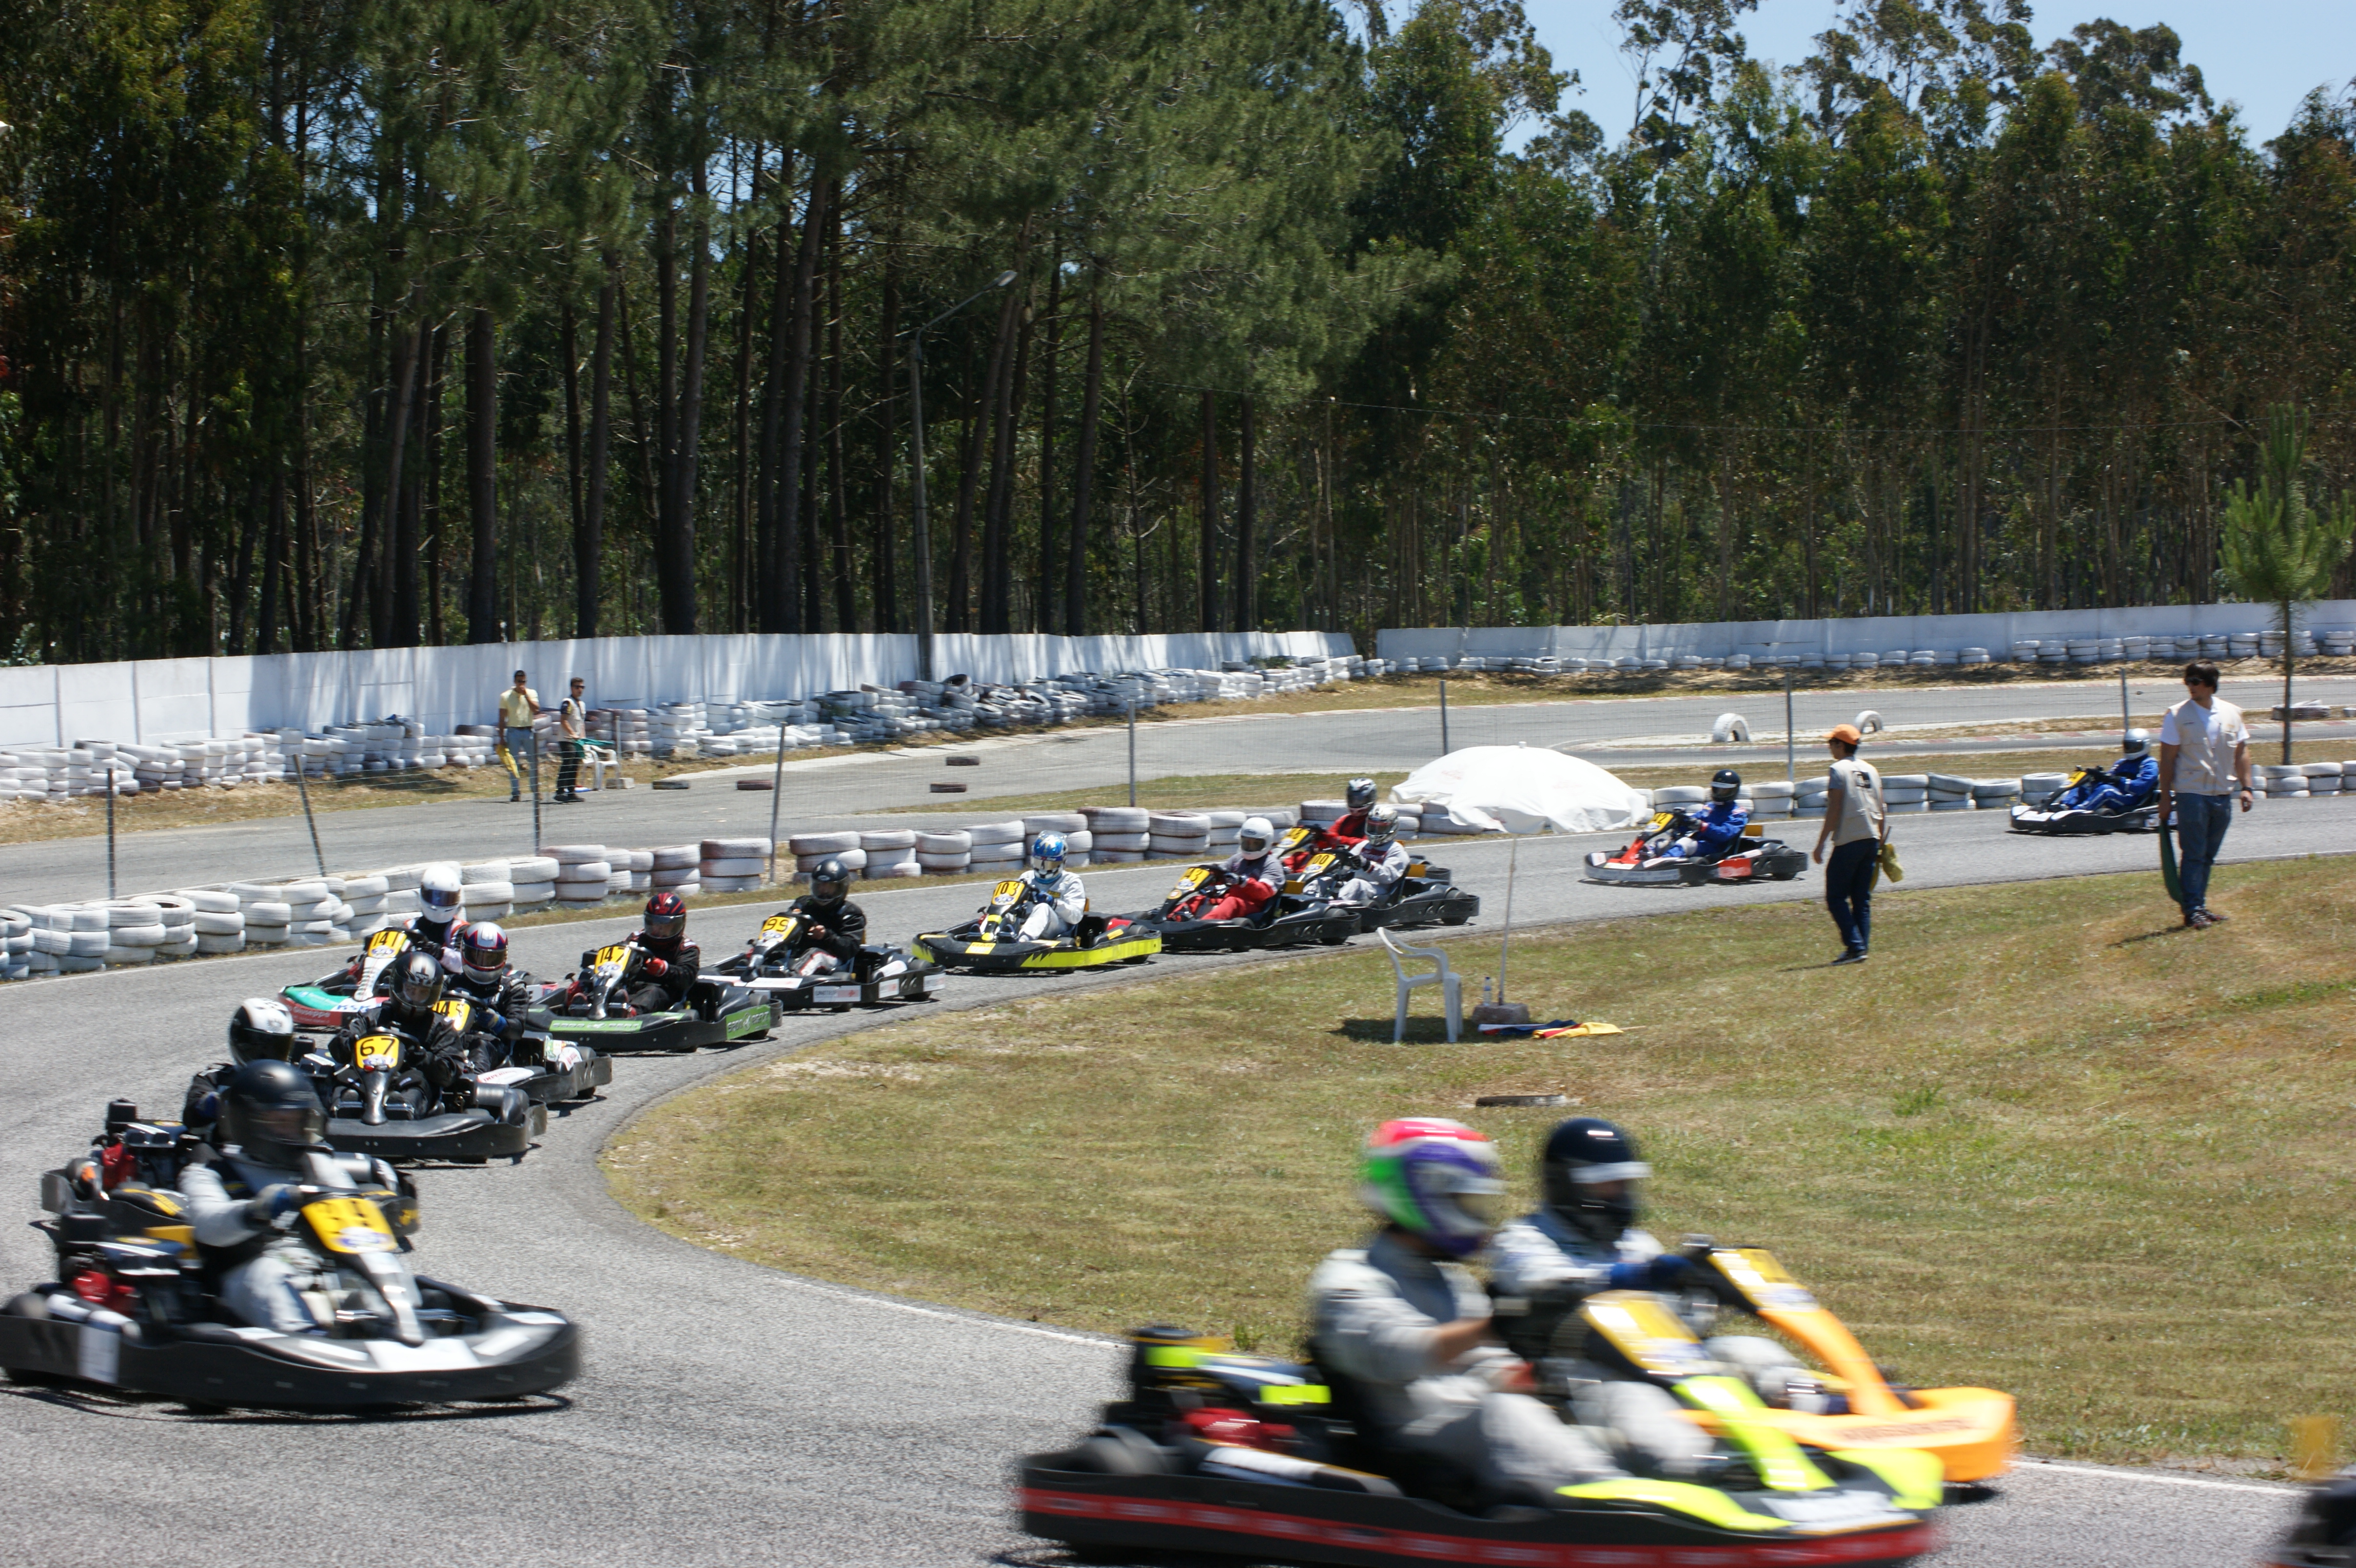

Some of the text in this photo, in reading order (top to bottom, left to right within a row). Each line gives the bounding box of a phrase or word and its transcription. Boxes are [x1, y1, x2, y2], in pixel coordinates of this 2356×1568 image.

[995, 882, 1020, 897] 103
[763, 918, 789, 932] 99
[372, 932, 400, 947] 141
[599, 946, 629, 963] 147
[360, 1037, 396, 1056] 67
